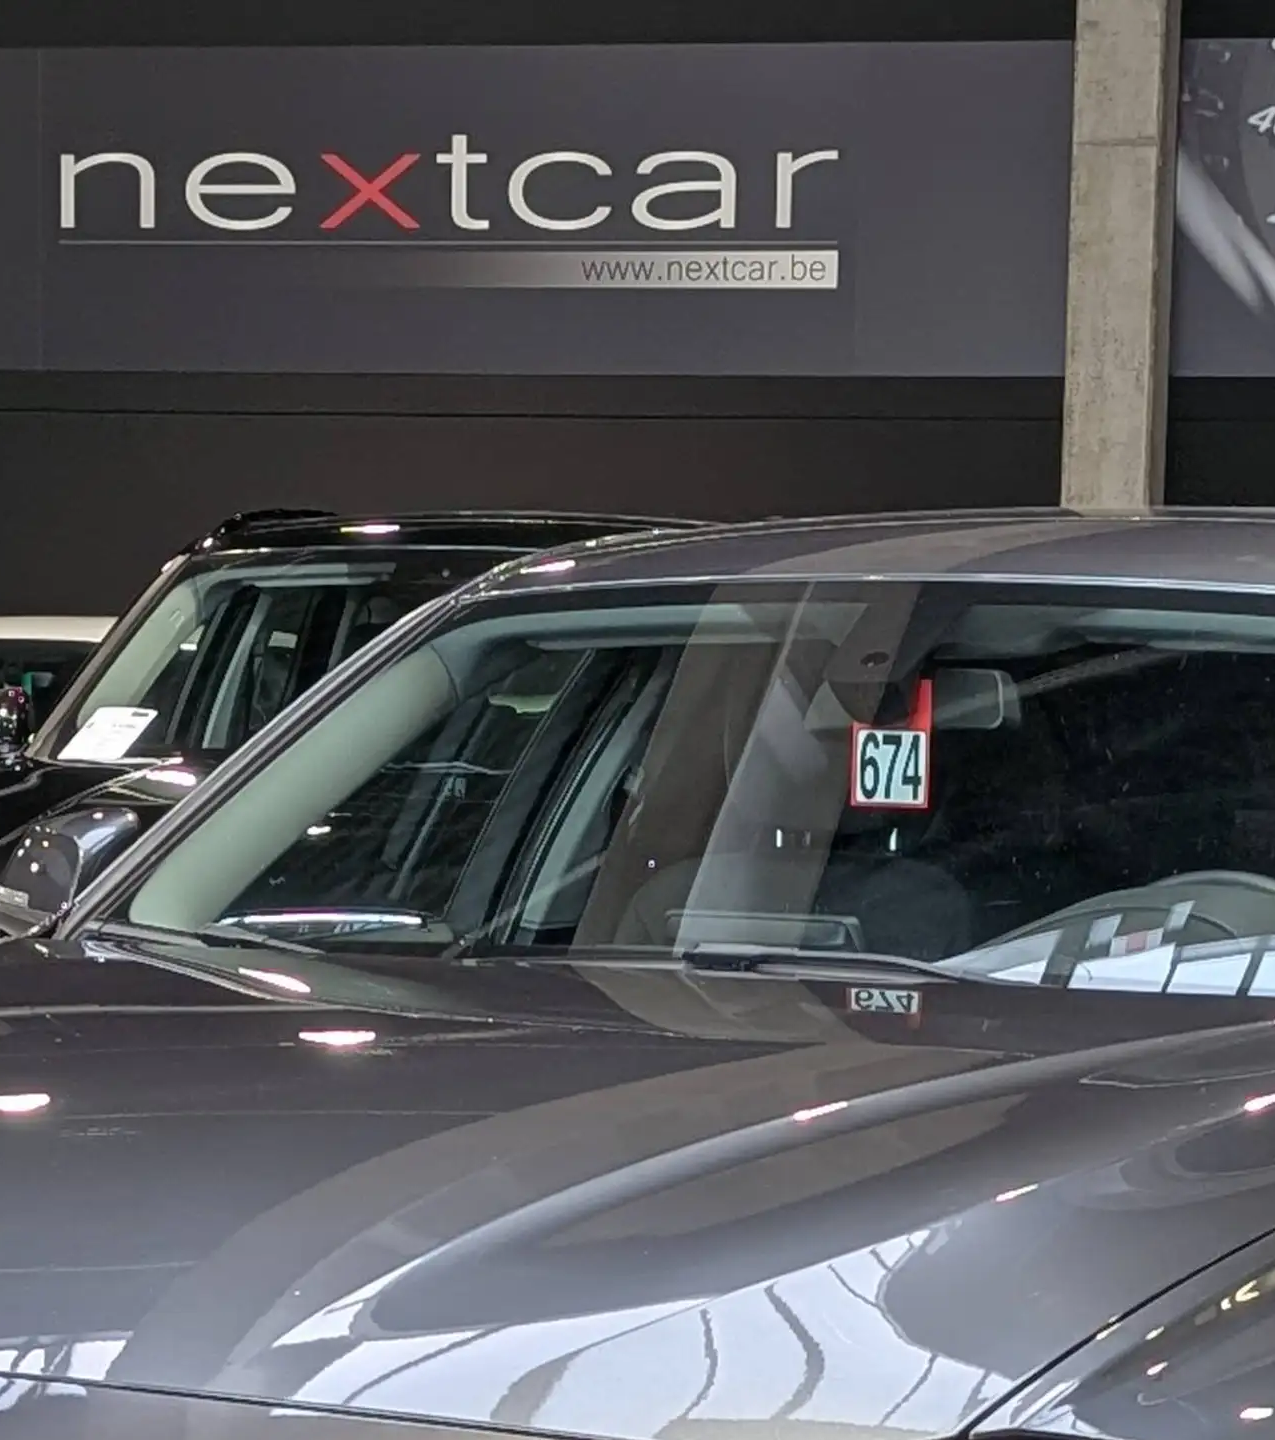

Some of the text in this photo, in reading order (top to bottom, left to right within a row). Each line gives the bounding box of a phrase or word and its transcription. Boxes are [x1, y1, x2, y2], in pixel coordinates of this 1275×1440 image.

[59, 134, 840, 231] nextcar
[581, 254, 828, 284] www.nextcar.be
[860, 732, 922, 800] 674
